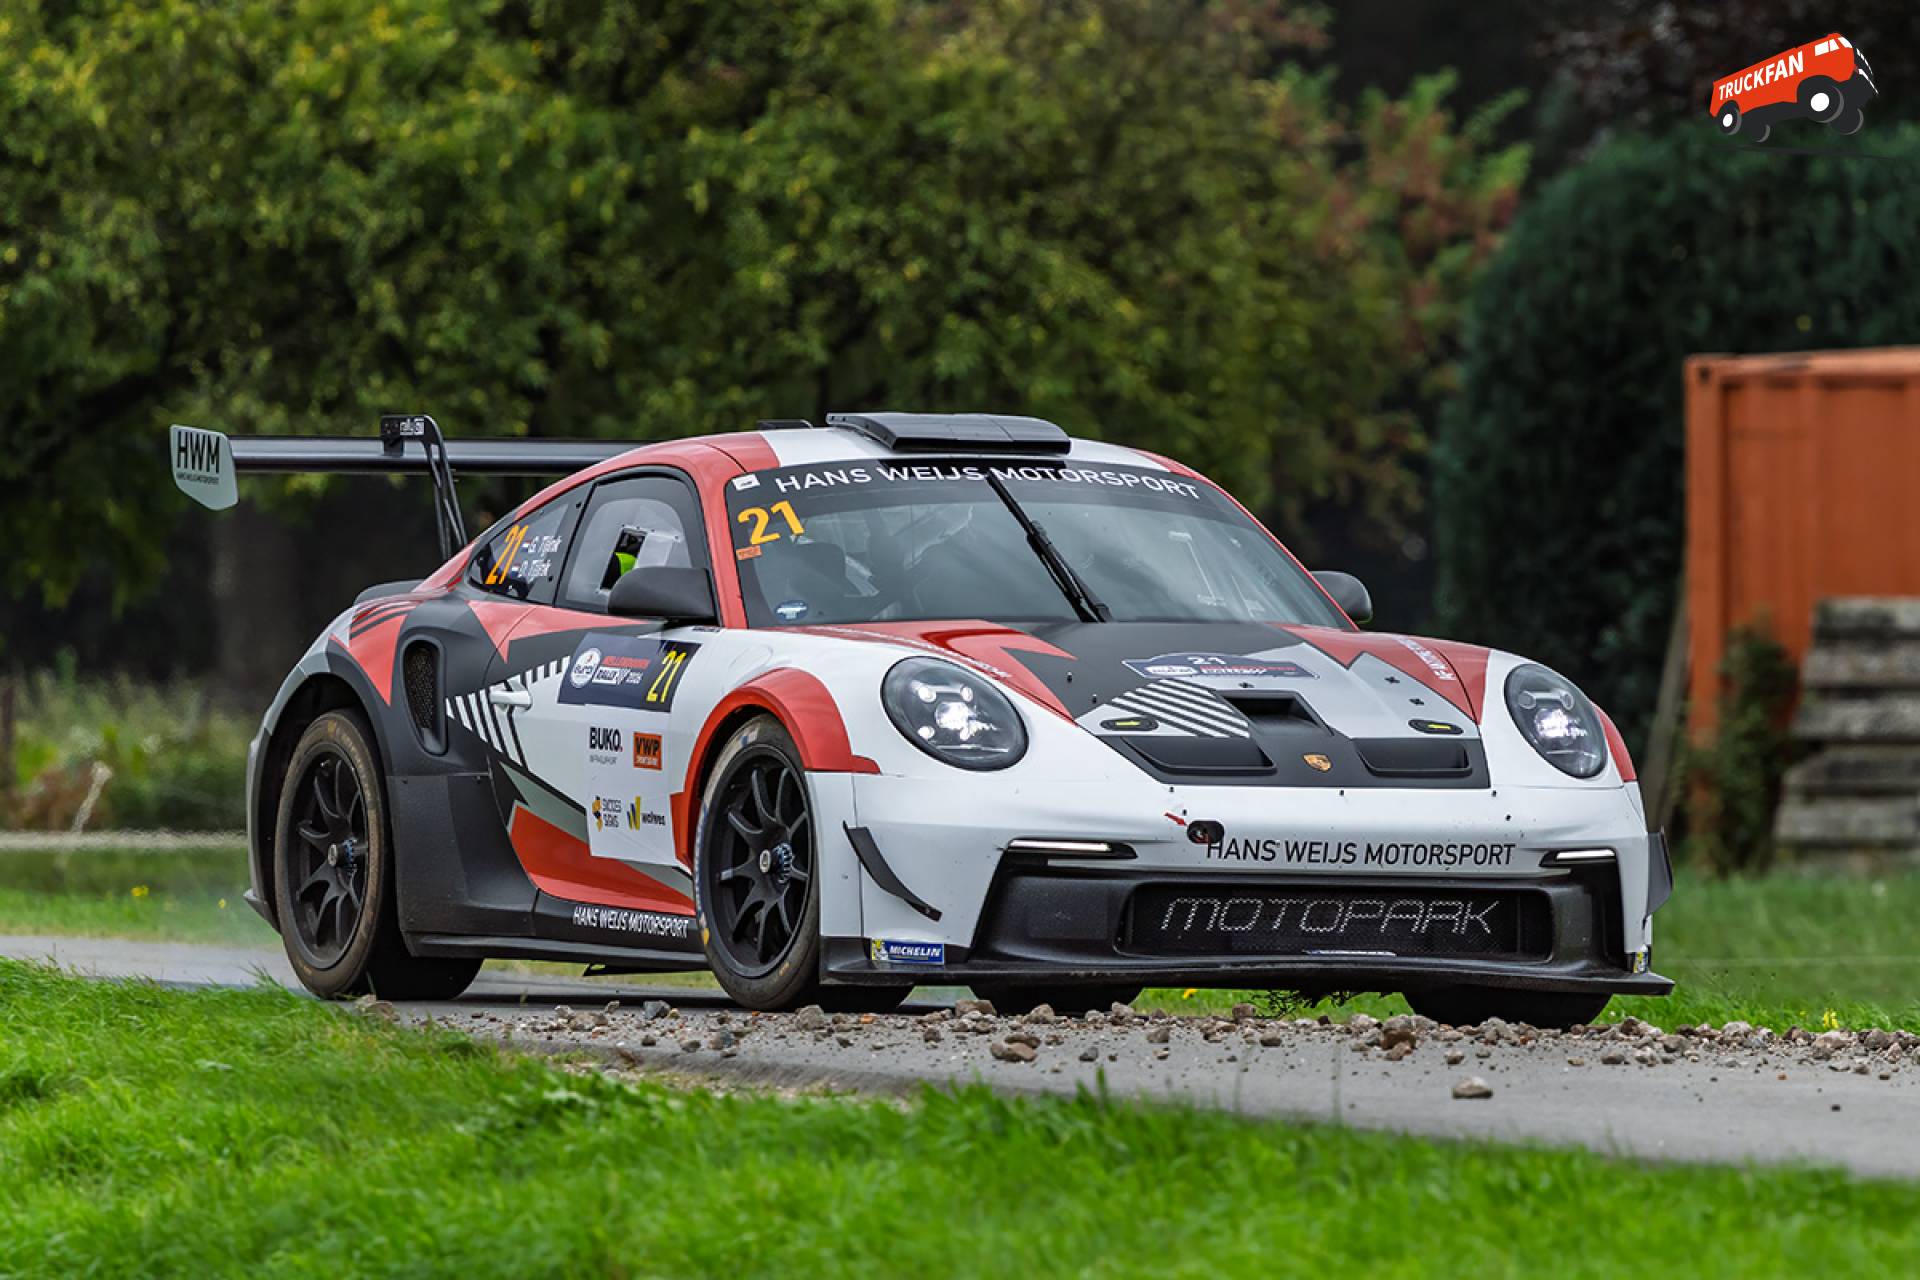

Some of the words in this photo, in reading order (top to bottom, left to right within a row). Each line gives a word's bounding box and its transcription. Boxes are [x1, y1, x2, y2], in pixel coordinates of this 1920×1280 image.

[177, 431, 220, 474] HWM
[775, 468, 871, 493] HANS
[875, 466, 987, 481] WEIJS
[989, 466, 1200, 499] MOTORSPORT
[737, 500, 804, 545] 21
[485, 524, 529, 585] 21
[646, 650, 687, 703] 21
[1187, 656, 1226, 665] 21
[589, 727, 623, 752] BUKO.
[635, 737, 660, 756] VWP
[1208, 839, 1277, 862] HANS
[1285, 841, 1357, 864] WEIJS
[1364, 842, 1516, 866] MOTORSPORT
[573, 906, 599, 927] HANS
[599, 909, 628, 931] WEIJS
[628, 913, 689, 938] MOTORSPORT
[1160, 896, 1500, 935] MOTOPARK
[889, 945, 941, 958] MICHELIN
